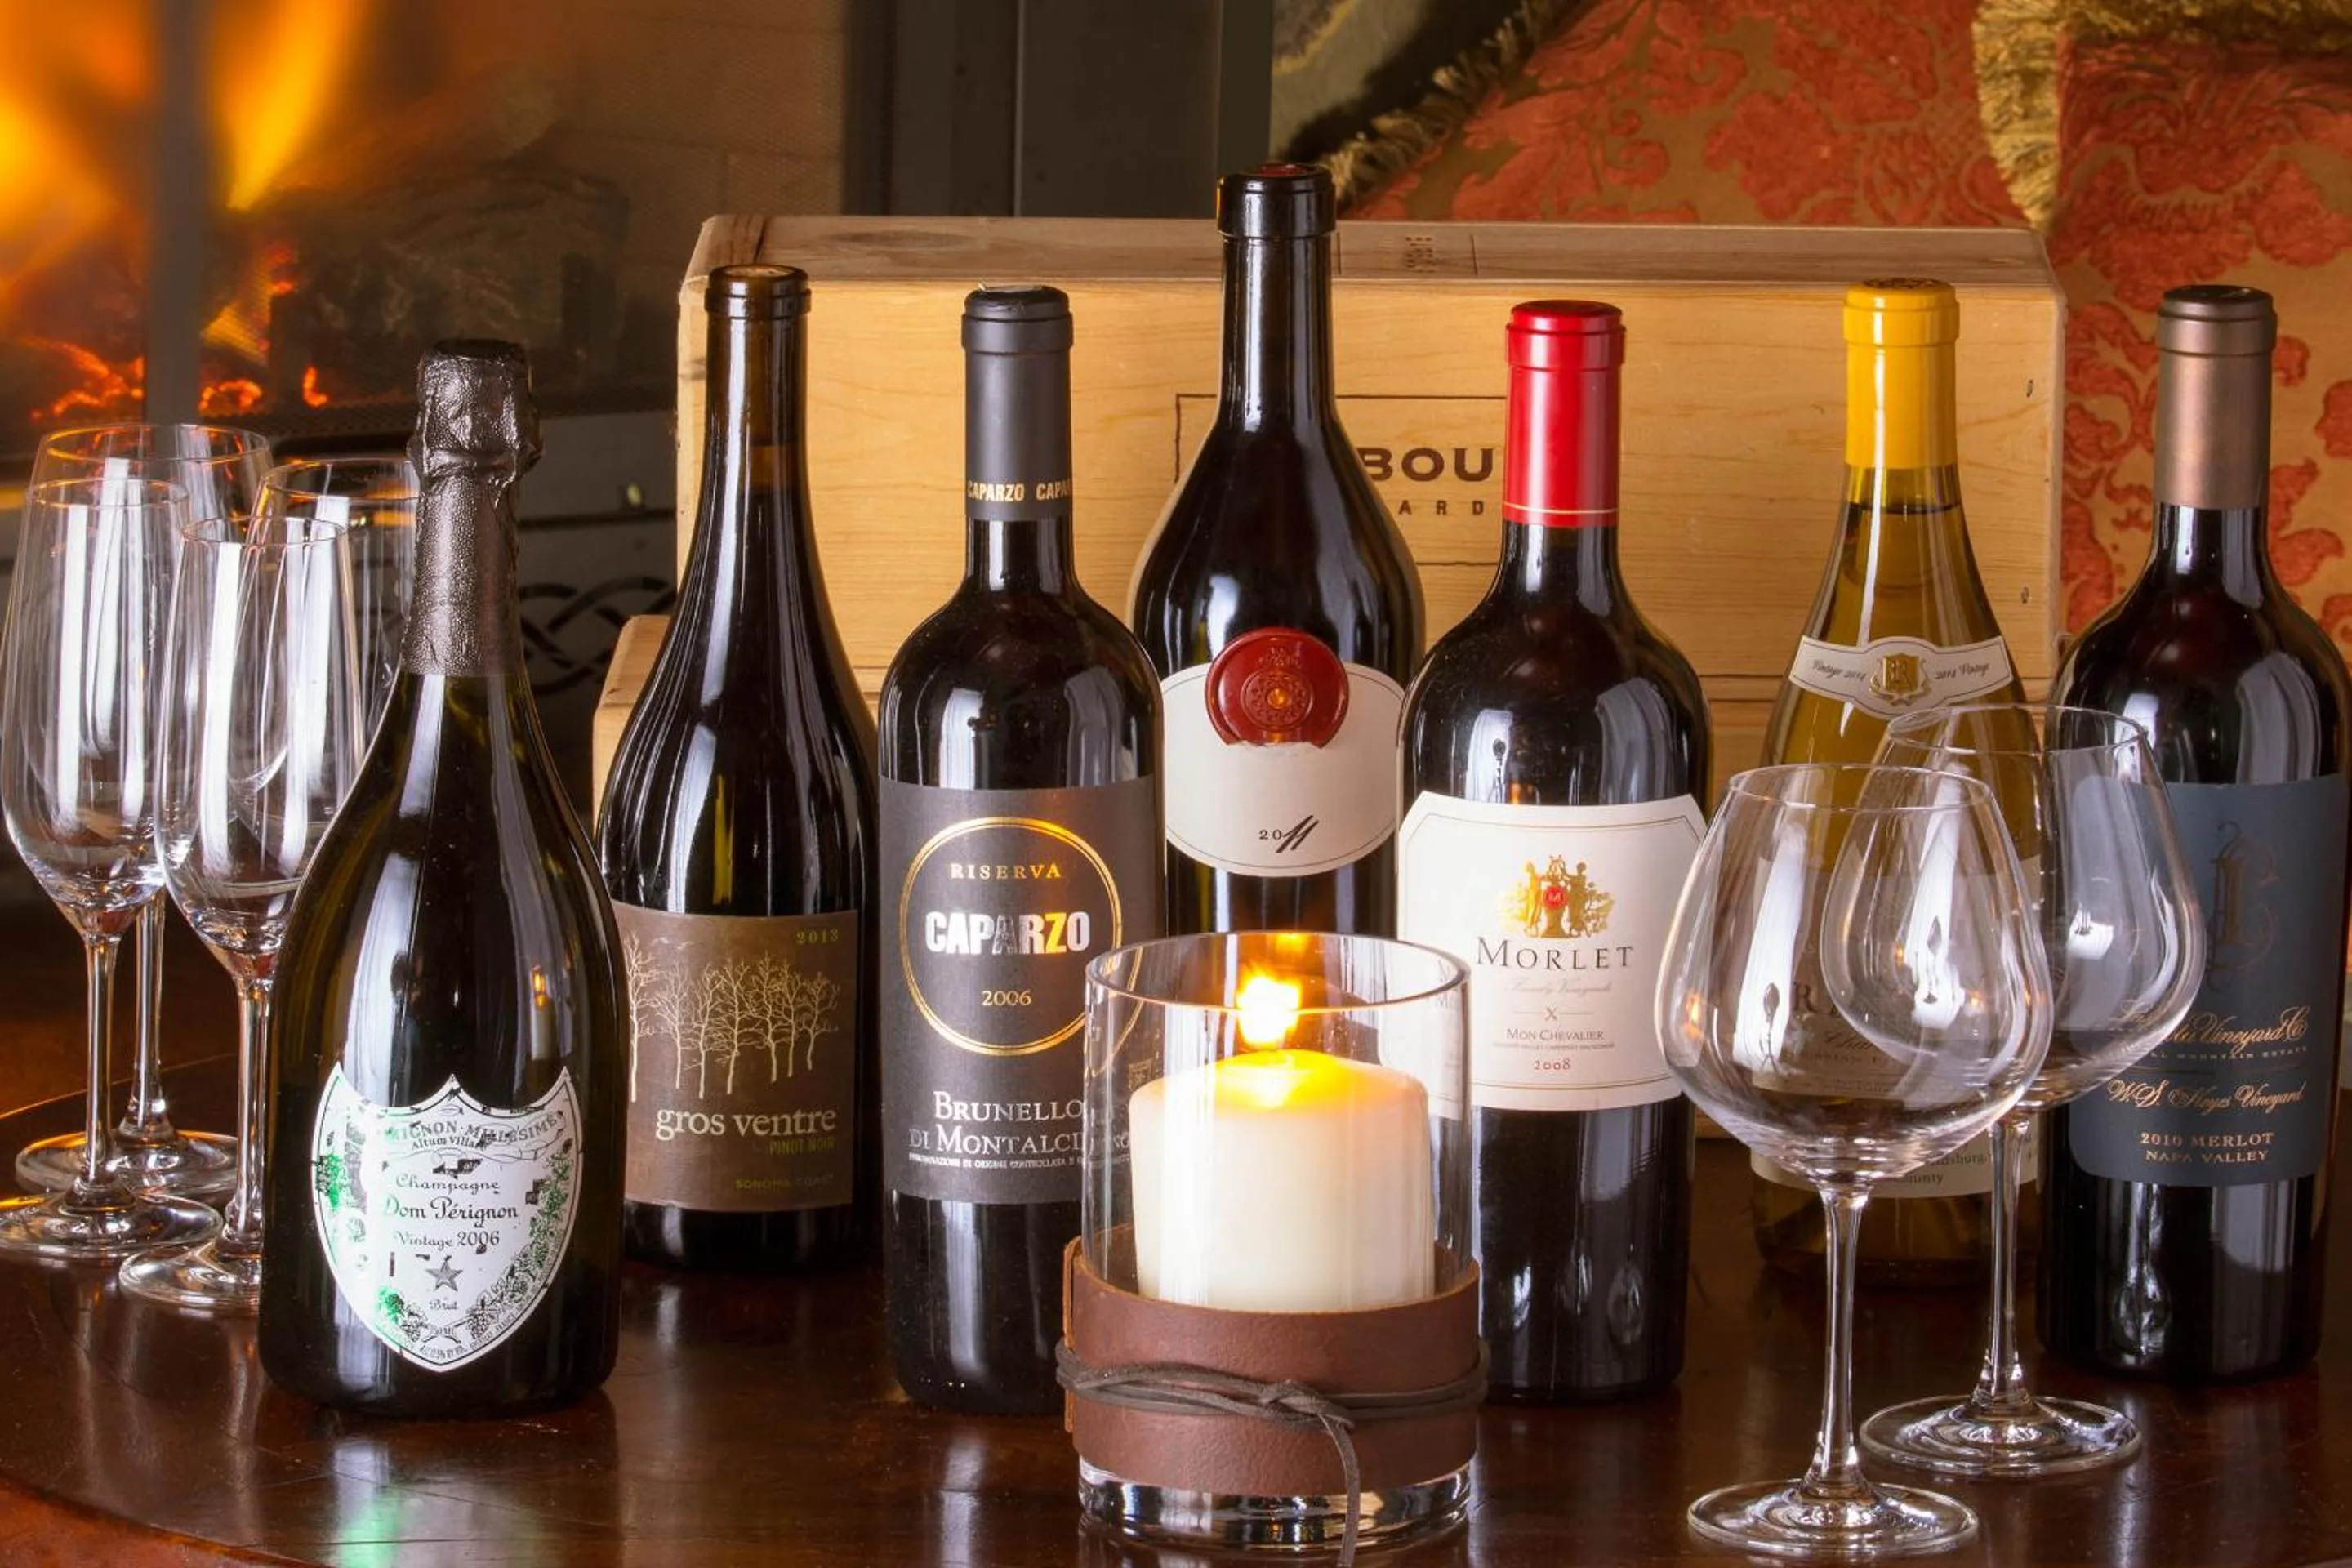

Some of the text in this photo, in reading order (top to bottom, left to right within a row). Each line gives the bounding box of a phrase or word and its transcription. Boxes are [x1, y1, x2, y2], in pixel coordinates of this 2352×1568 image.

[968, 479, 1071, 502] CAPARZO CAPA
[950, 862, 1062, 881] RISERVA
[795, 928, 839, 945] 2013
[925, 911, 1091, 956] CAPARZO
[1477, 937, 1633, 971] MORLET
[981, 989, 1031, 1006] 2006
[1506, 1027, 1605, 1041] MON CHEVALIER
[1534, 1058, 1571, 1071] 2008
[933, 1090, 1085, 1122] BRUNELLO
[2234, 1080, 2308, 1114] Vineyard
[655, 1107, 837, 1142] gros ventre
[411, 1137, 448, 1152] Altum
[908, 1128, 930, 1151] DI
[2140, 1131, 2275, 1148] 2010 MERLOT
[2145, 1149, 2270, 1164] NAPA VALLEY
[395, 1173, 501, 1196] Champagne
[384, 1193, 519, 1228] Dom Pérignon
[395, 1230, 501, 1251] Vintage 2006
